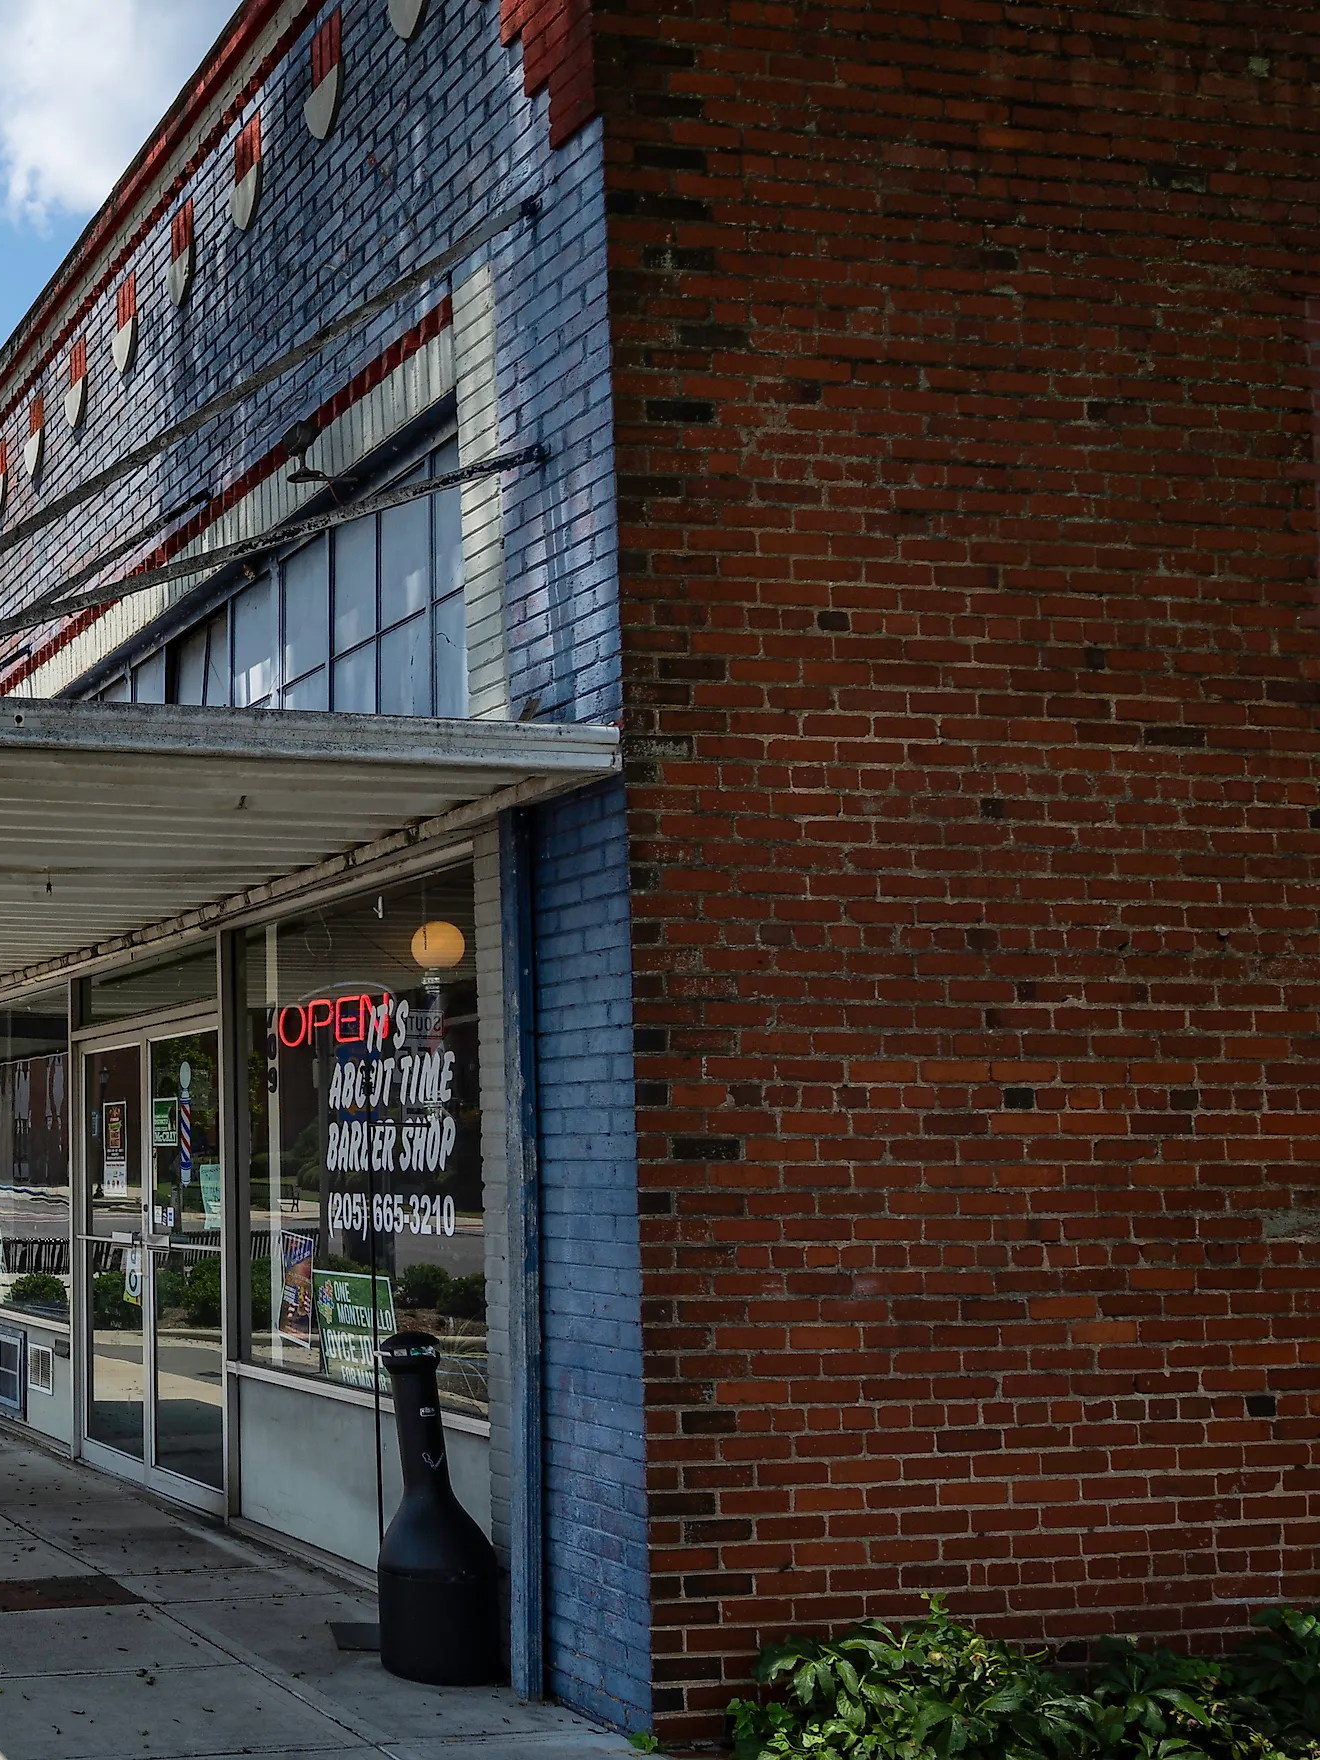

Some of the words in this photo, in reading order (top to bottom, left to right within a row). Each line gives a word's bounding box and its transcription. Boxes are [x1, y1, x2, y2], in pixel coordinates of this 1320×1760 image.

[279, 992, 389, 1047] OPEN
[367, 999, 410, 1053] IT'S
[329, 1057, 396, 1110] ABOUT
[400, 1050, 456, 1105] TIME
[326, 1118, 396, 1172] BARBER
[399, 1116, 456, 1172] SHOP
[328, 1192, 368, 1241] (205)
[372, 1194, 456, 1237] 665-3210
[333, 1280, 352, 1303] ONE
[336, 1302, 393, 1332] MONTEVLLO
[323, 1328, 359, 1363] JOYCE
[341, 1365, 358, 1385] FOR
